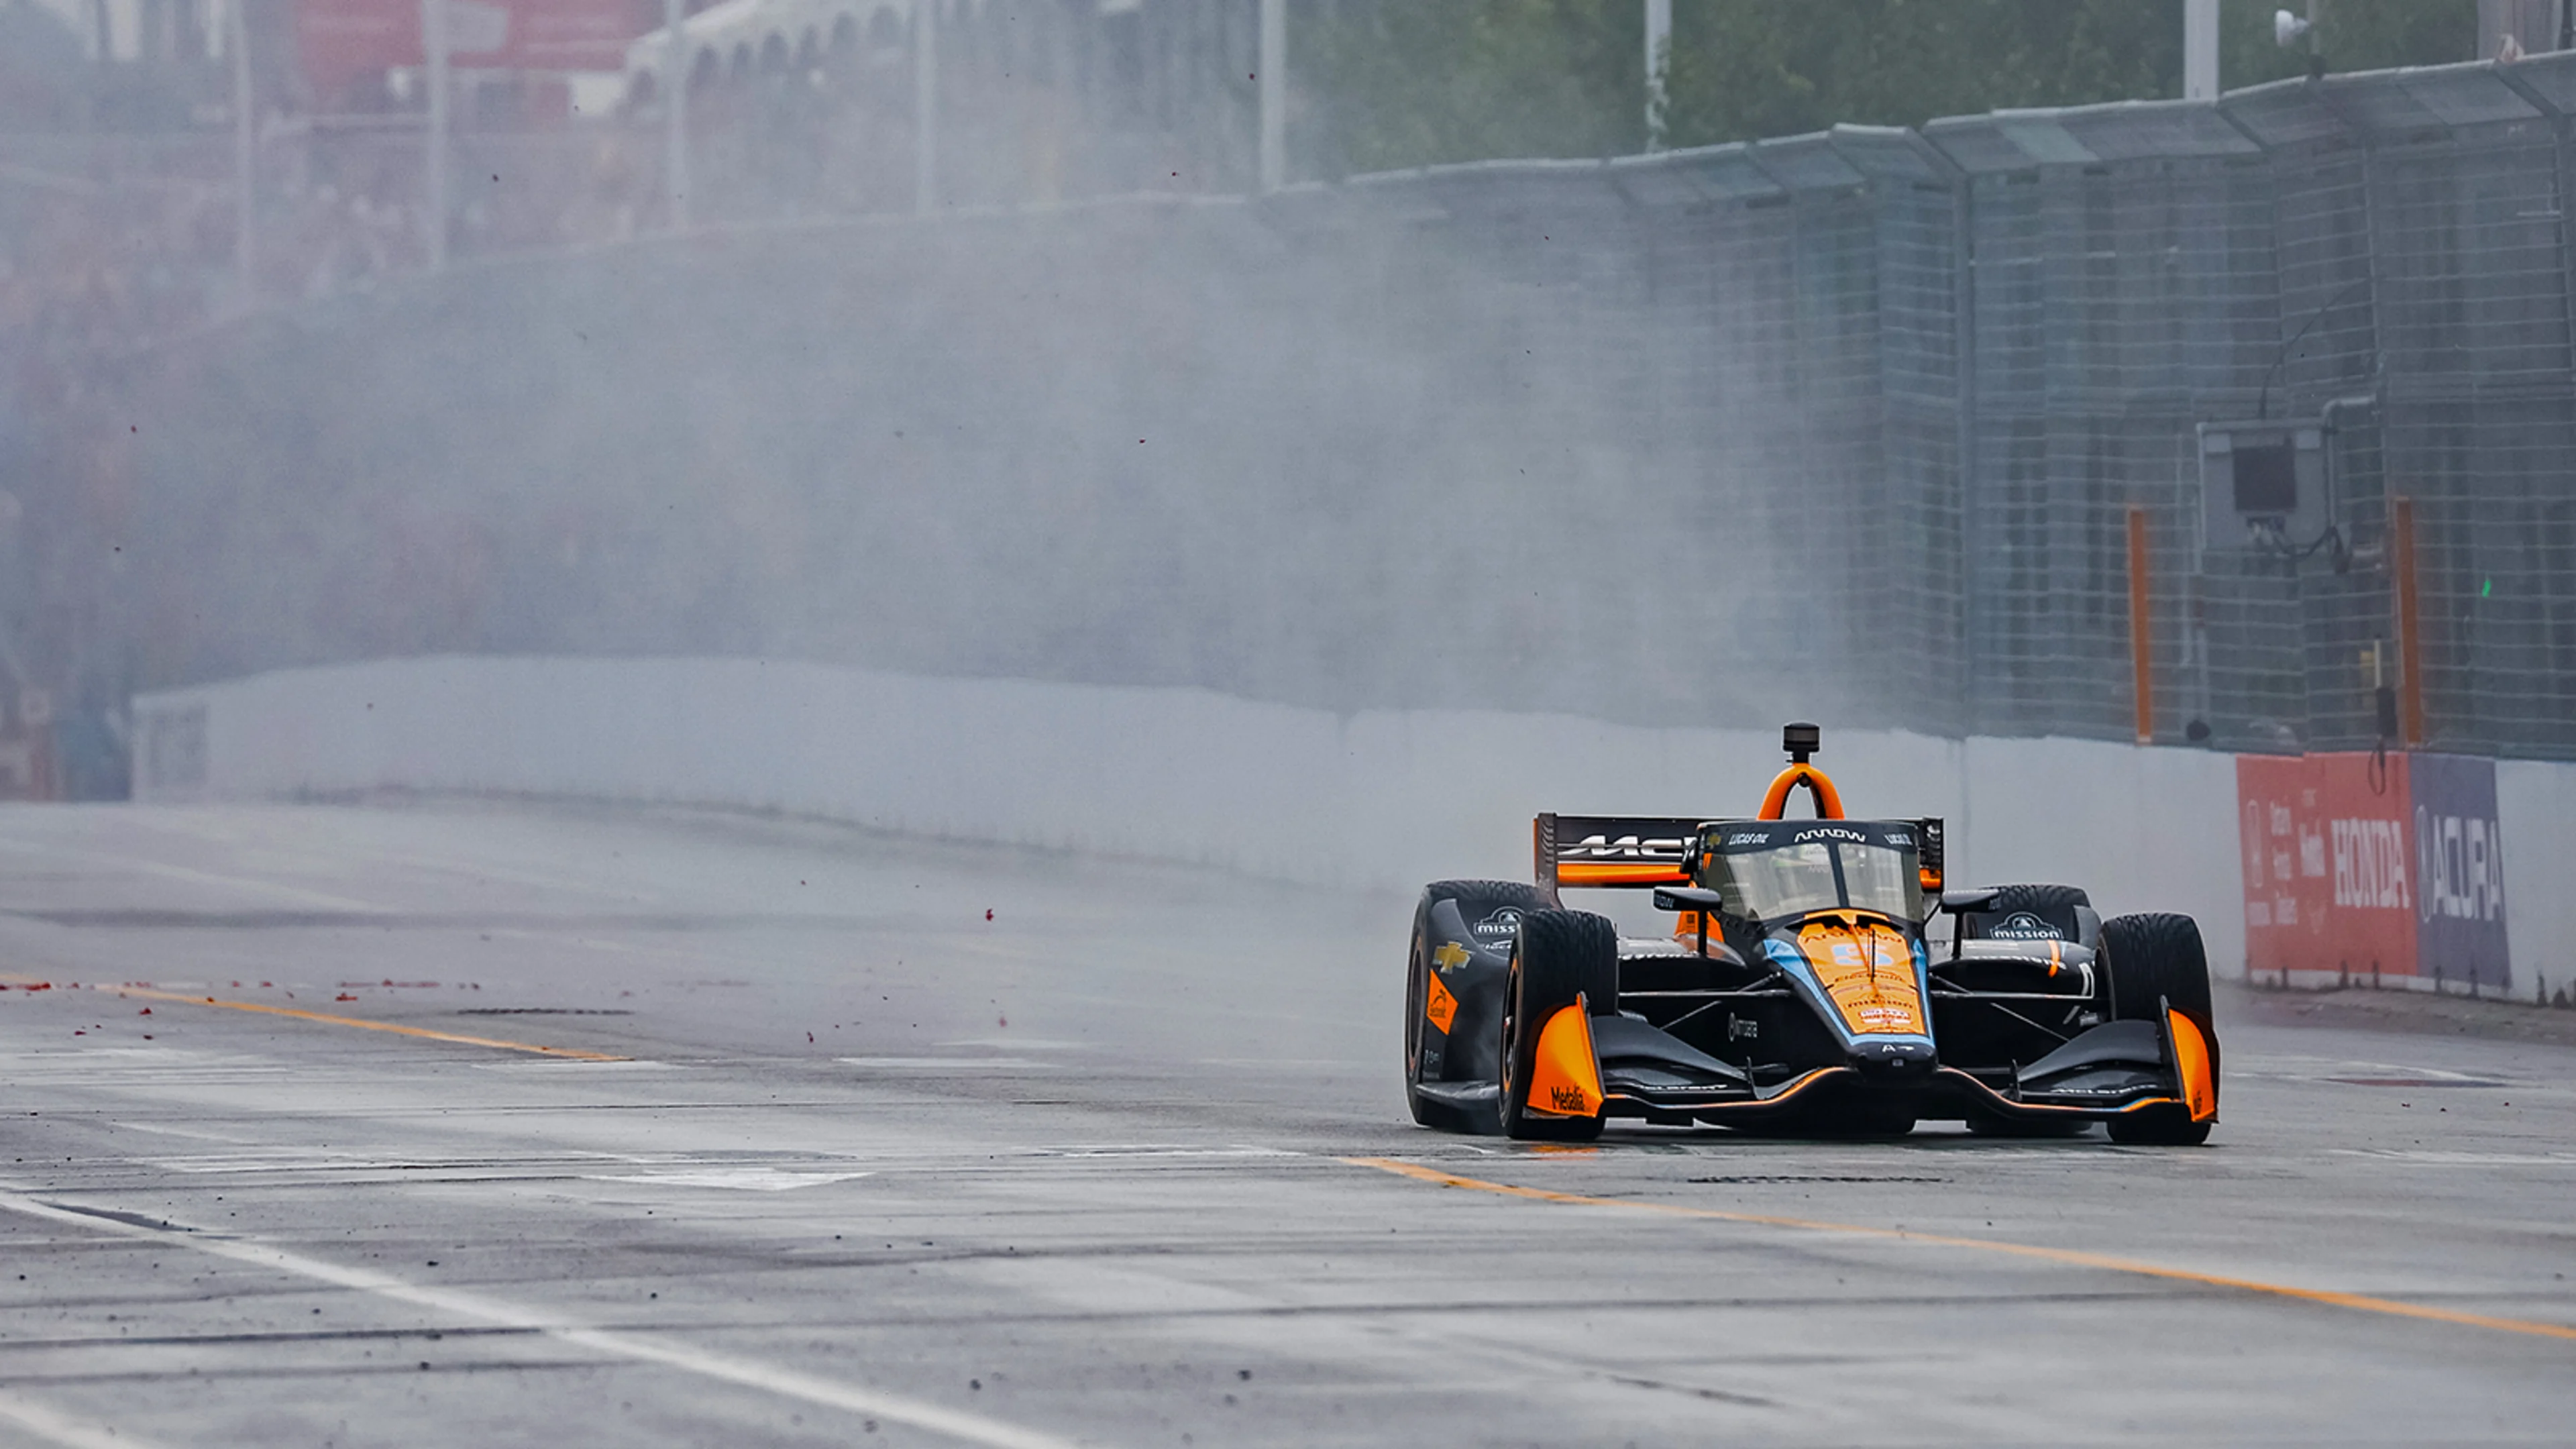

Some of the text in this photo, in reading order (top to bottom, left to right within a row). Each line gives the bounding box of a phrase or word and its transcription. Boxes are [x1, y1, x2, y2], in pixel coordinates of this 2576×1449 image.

[1794, 828, 1866, 843] ARROW
[2331, 817, 2410, 909] HONDA
[2432, 815, 2506, 921] ACURA
[1994, 928, 2059, 938] mission
